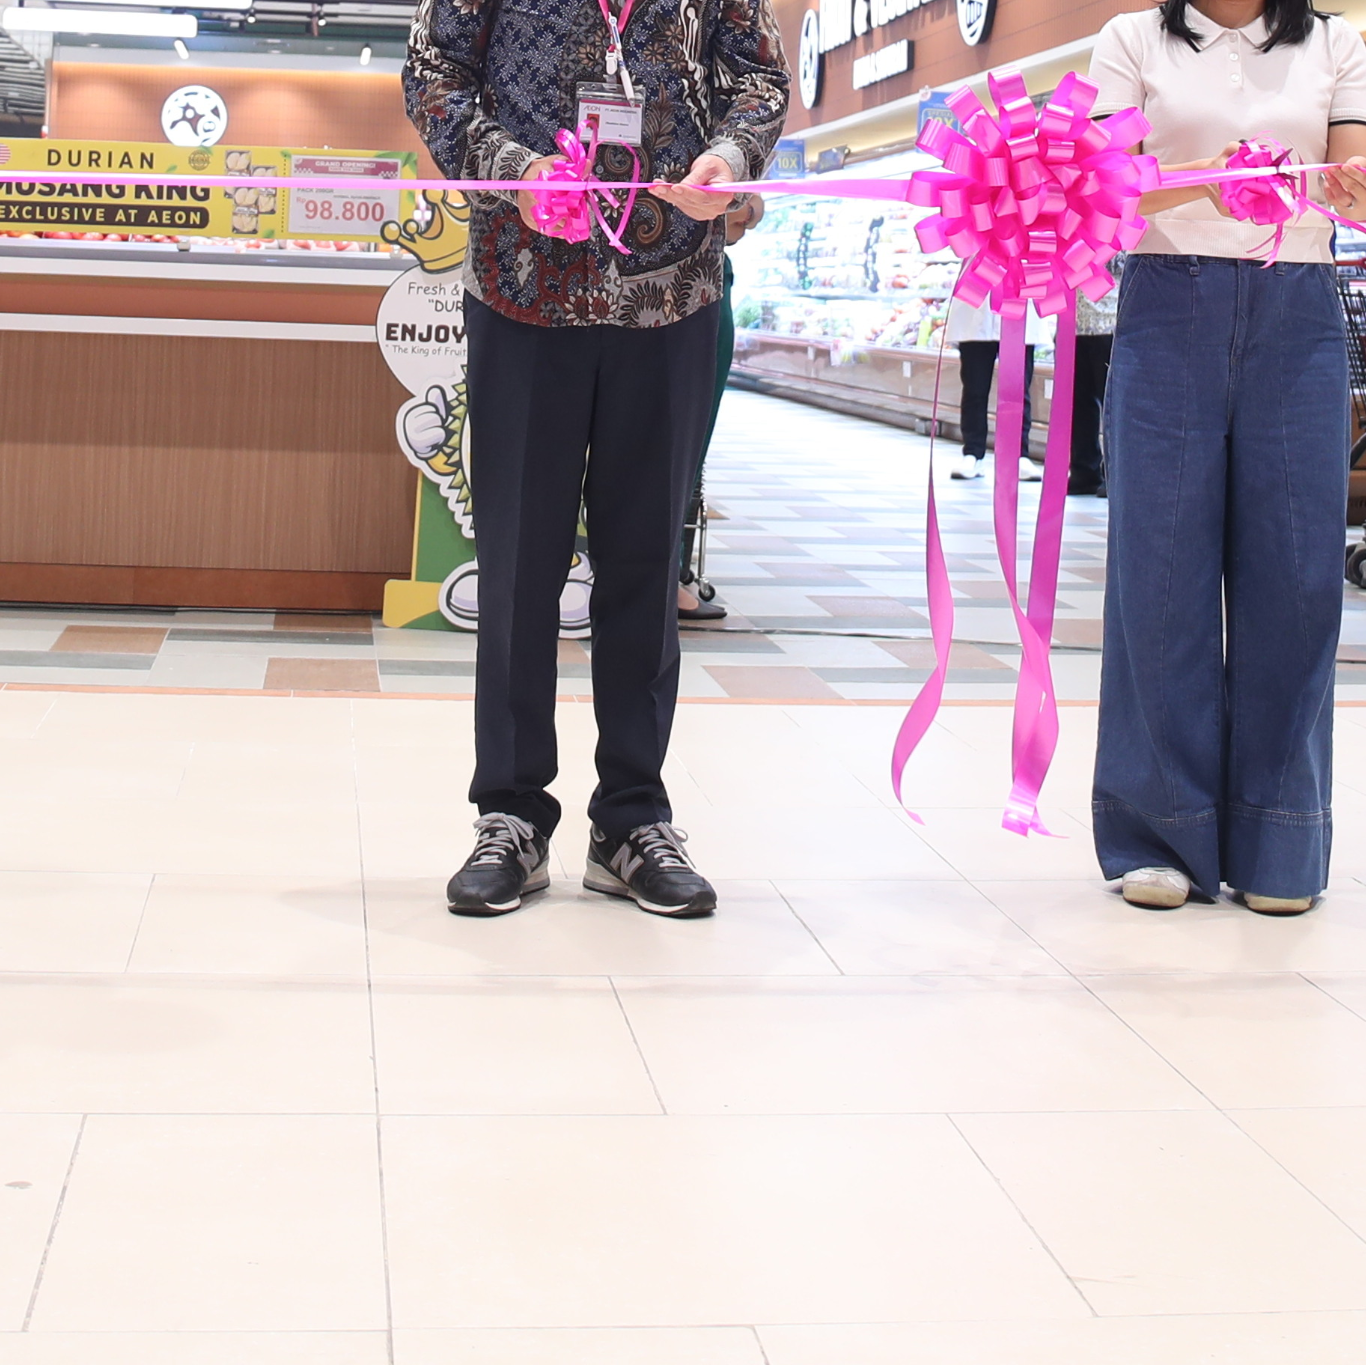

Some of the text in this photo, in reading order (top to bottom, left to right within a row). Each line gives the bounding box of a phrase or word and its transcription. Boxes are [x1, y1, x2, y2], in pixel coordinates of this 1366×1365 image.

[46, 149, 155, 169] DURIAN
[134, 184, 211, 202] KING
[115, 209, 138, 223] AT
[147, 210, 201, 224] AEON
[304, 199, 385, 222] 98.800
[407, 282, 460, 296] Fresh &
[385, 323, 466, 343] ENJOY
[392, 345, 409, 354] The
[411, 346, 430, 357] King
[432, 346, 441, 355] of
